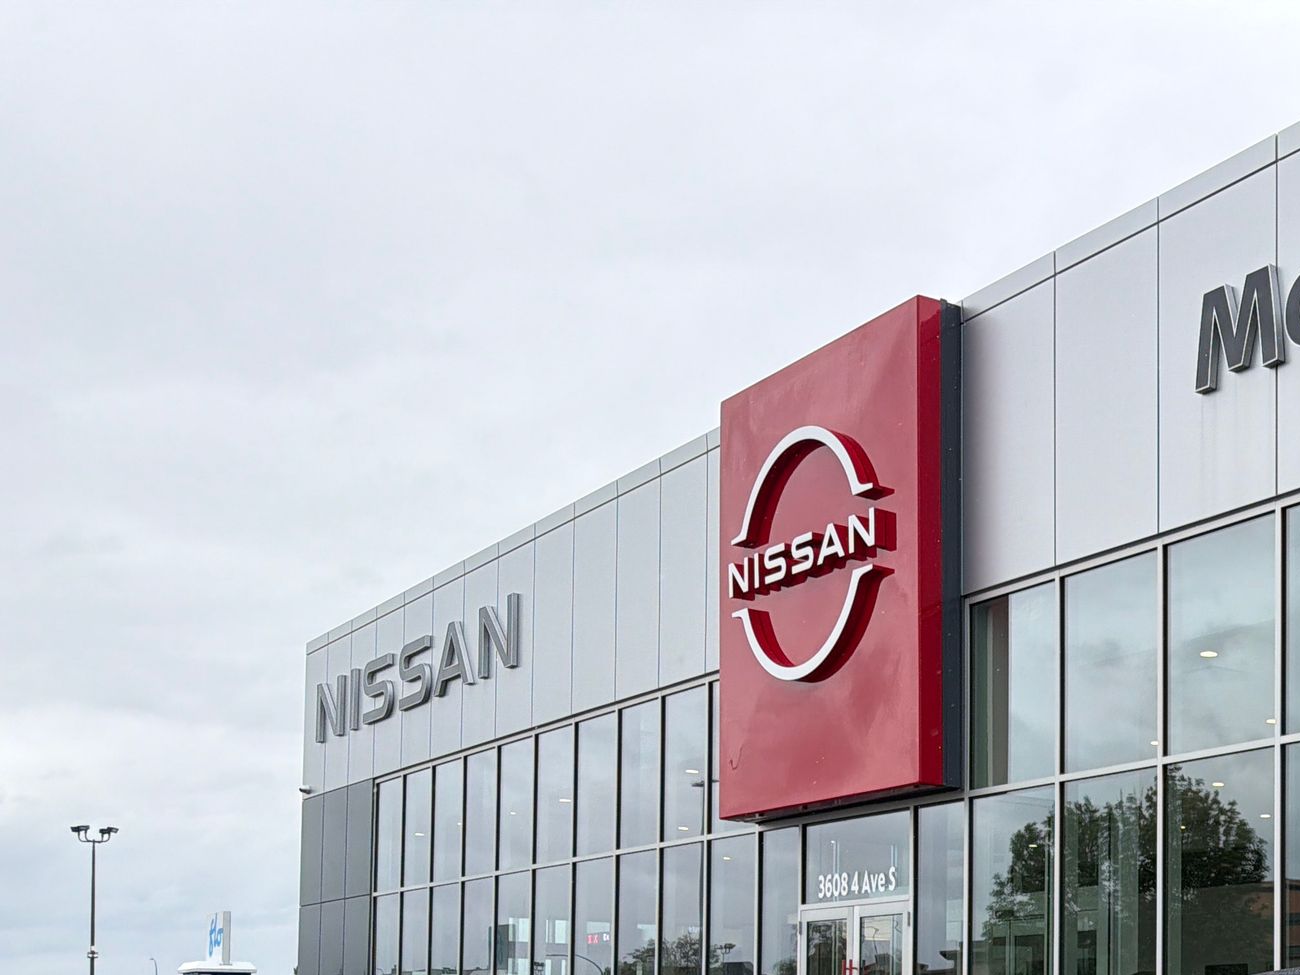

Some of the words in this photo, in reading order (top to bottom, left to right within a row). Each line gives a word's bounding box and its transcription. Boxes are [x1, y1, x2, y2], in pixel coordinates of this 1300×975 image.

[728, 507, 876, 598] NISSAN
[315, 592, 520, 743] NISSAN
[818, 872, 848, 898] 3608
[850, 871, 860, 894] 4
[861, 870, 886, 894] Ave
[888, 866, 896, 891] S
